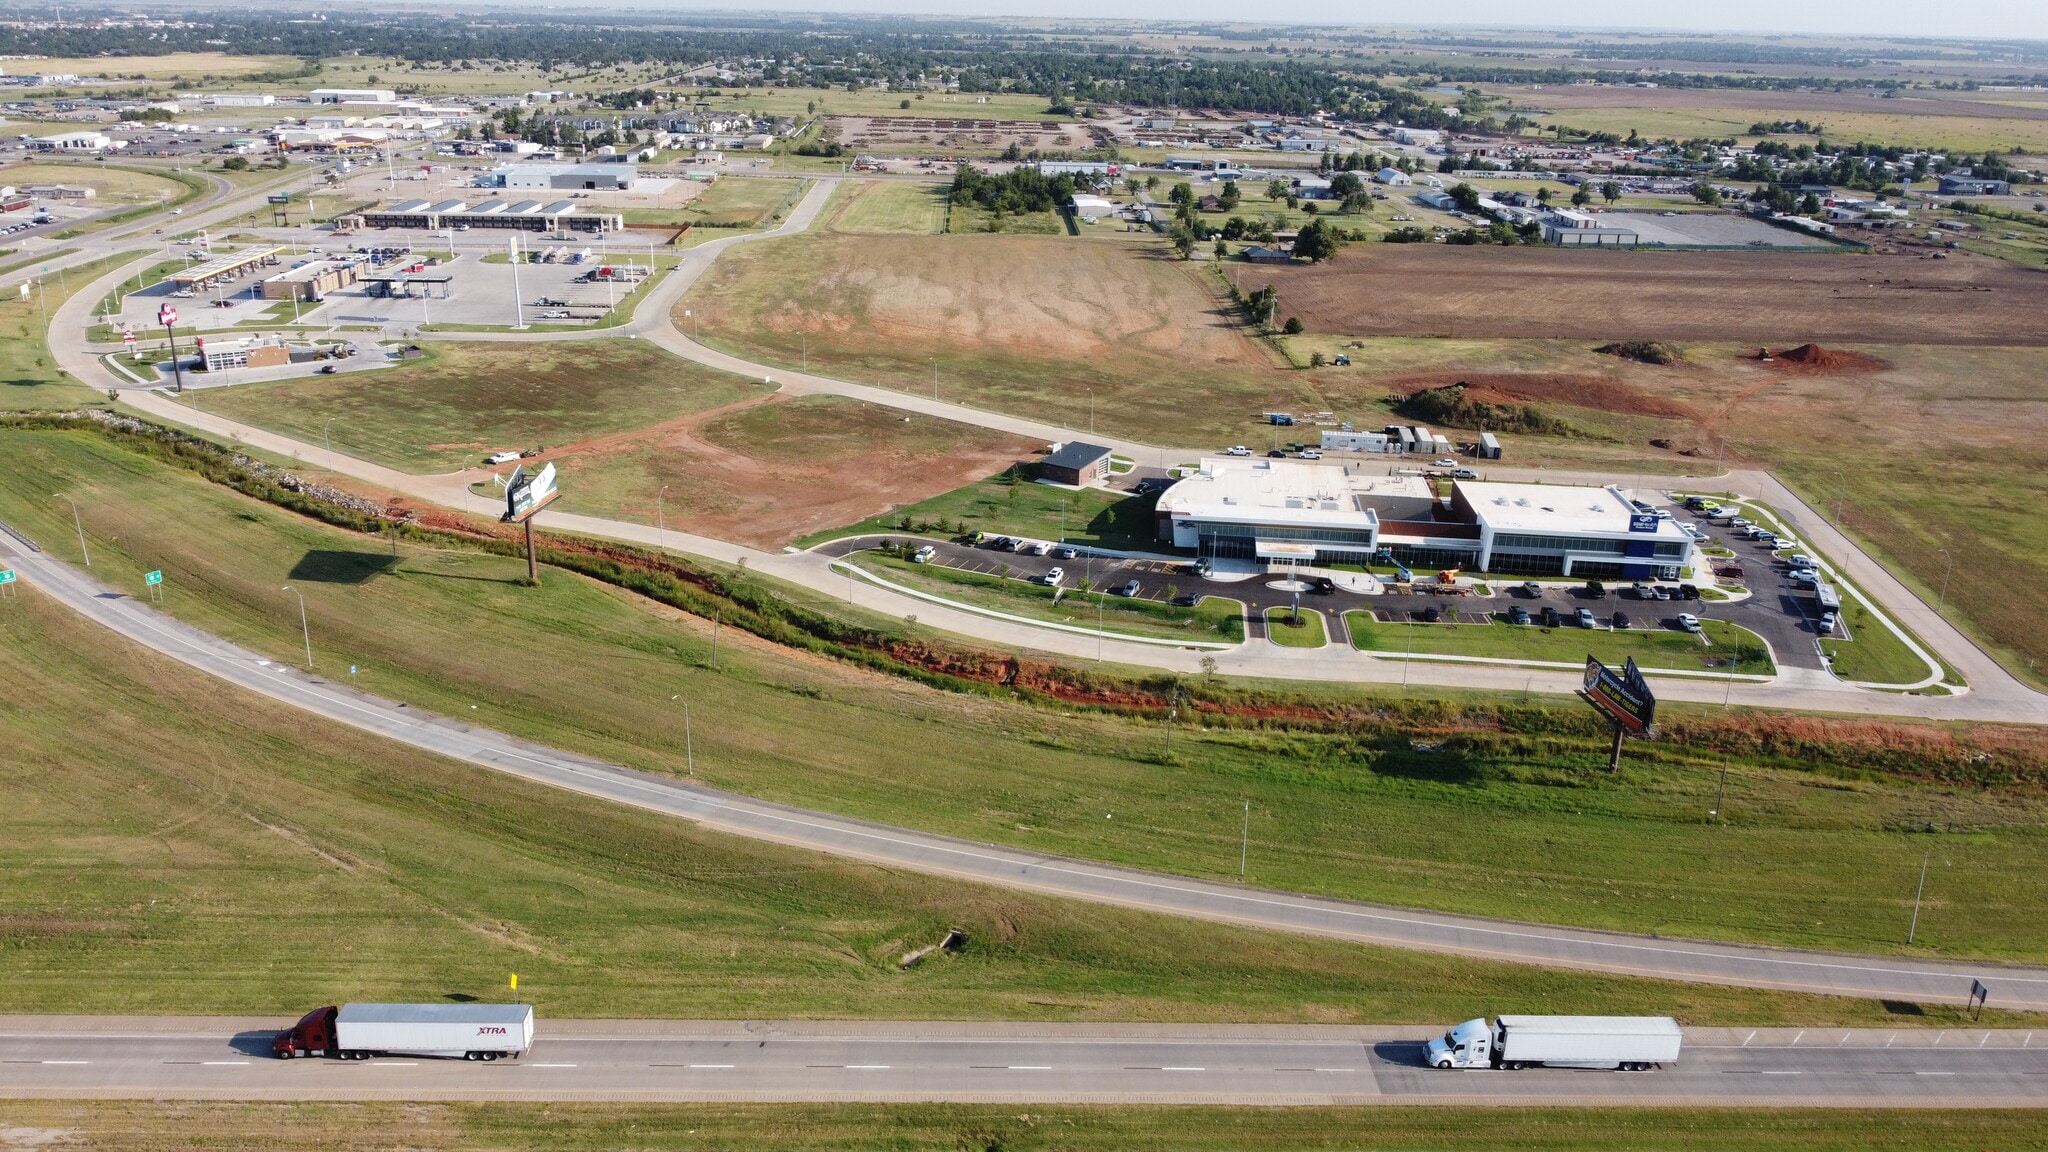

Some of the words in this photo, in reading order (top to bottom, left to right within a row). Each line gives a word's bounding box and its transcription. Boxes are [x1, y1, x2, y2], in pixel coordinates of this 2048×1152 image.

[1600, 671, 1621, 692] Motorcycle
[1621, 688, 1643, 707] Accident?
[476, 1027, 507, 1035] XTRA
